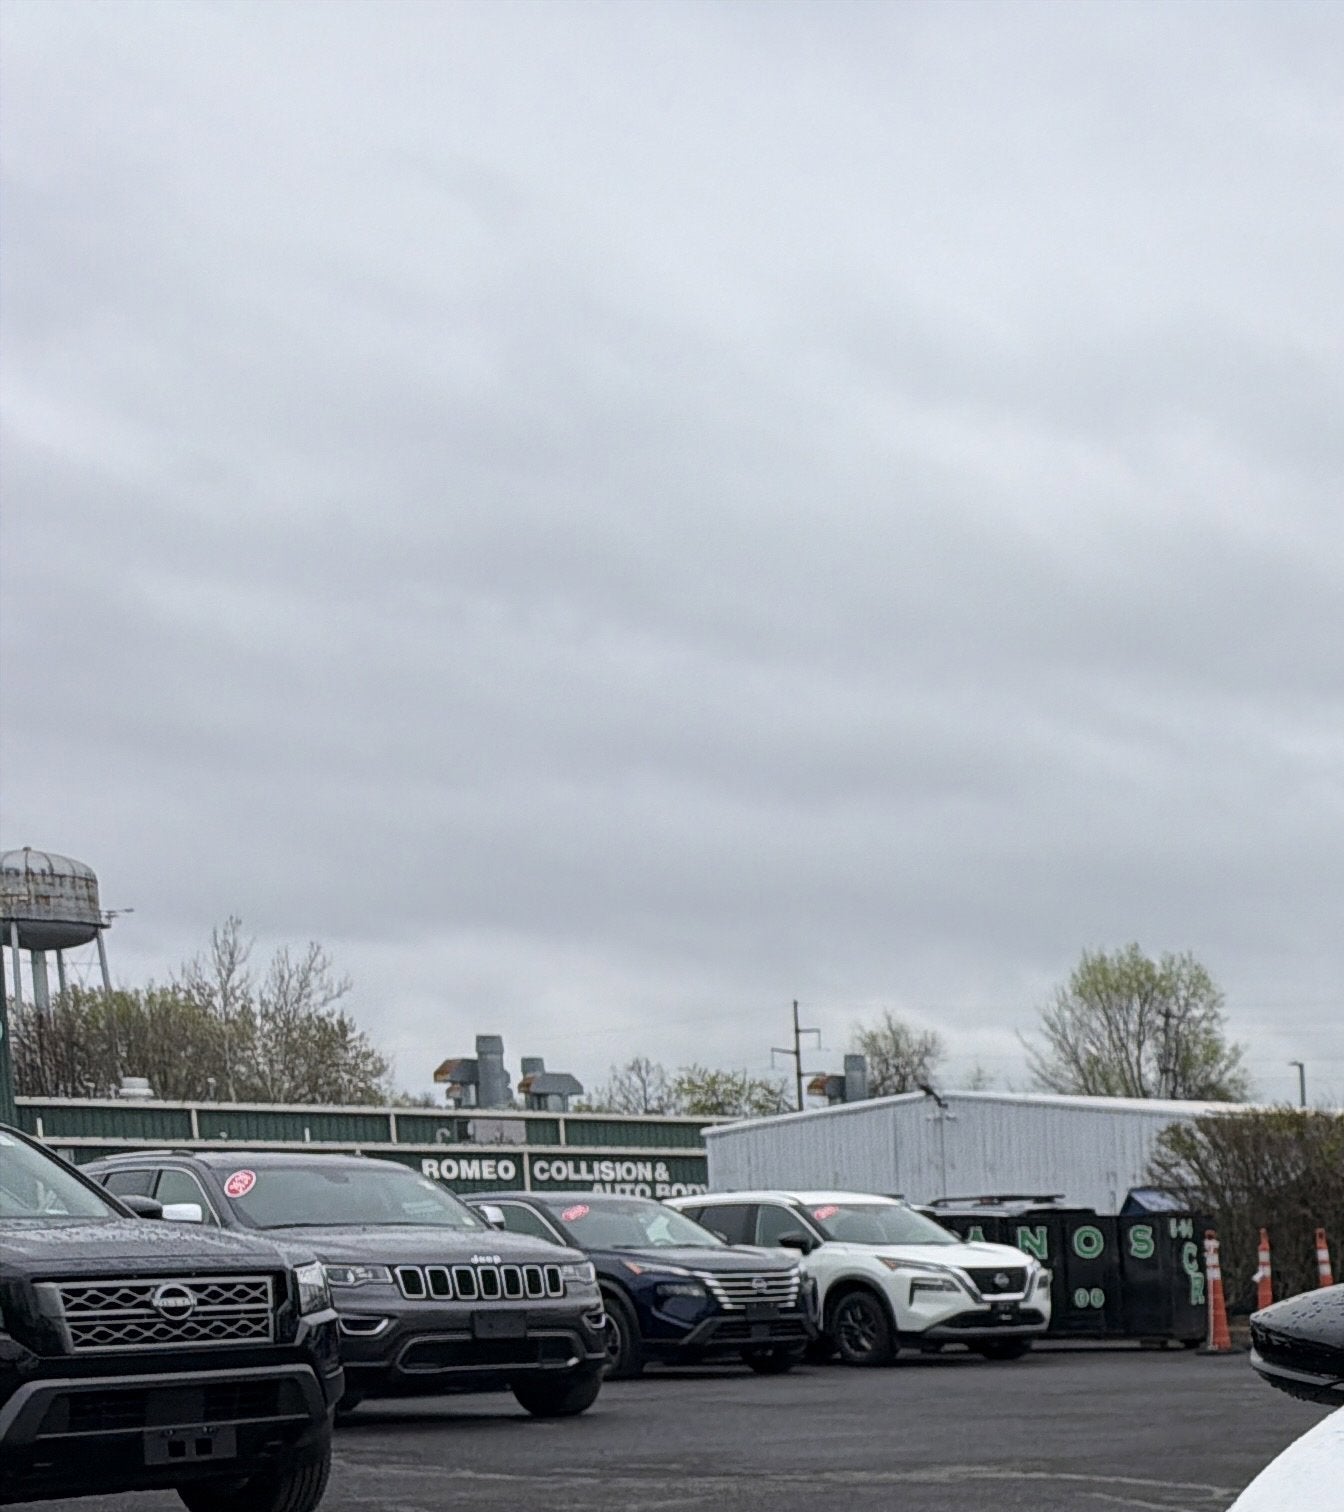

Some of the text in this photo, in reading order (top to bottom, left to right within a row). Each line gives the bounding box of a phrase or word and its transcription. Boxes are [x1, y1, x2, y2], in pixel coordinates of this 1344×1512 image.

[421, 1158, 670, 1182] ROMEO COLLISION &
[656, 1182, 708, 1197] BOD
